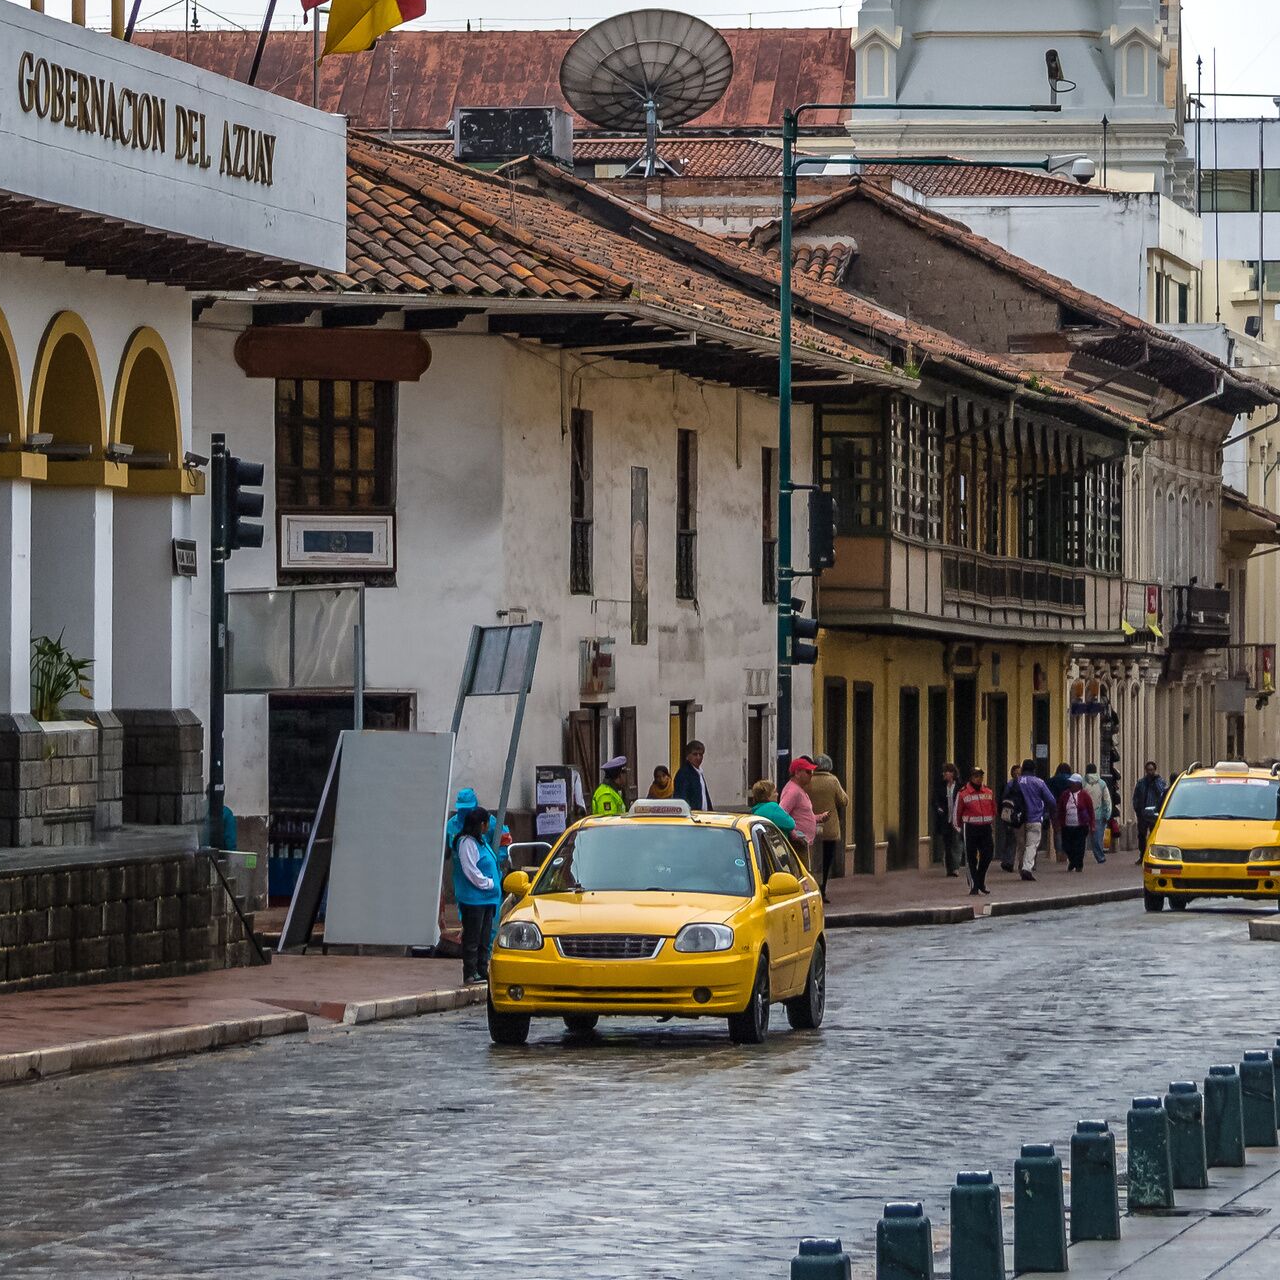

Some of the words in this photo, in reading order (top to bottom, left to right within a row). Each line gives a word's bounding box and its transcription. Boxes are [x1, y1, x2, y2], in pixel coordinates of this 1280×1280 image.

[17, 50, 166, 154] GOBERNACION
[174, 104, 211, 169] DEL
[219, 120, 277, 186] AZUAY
